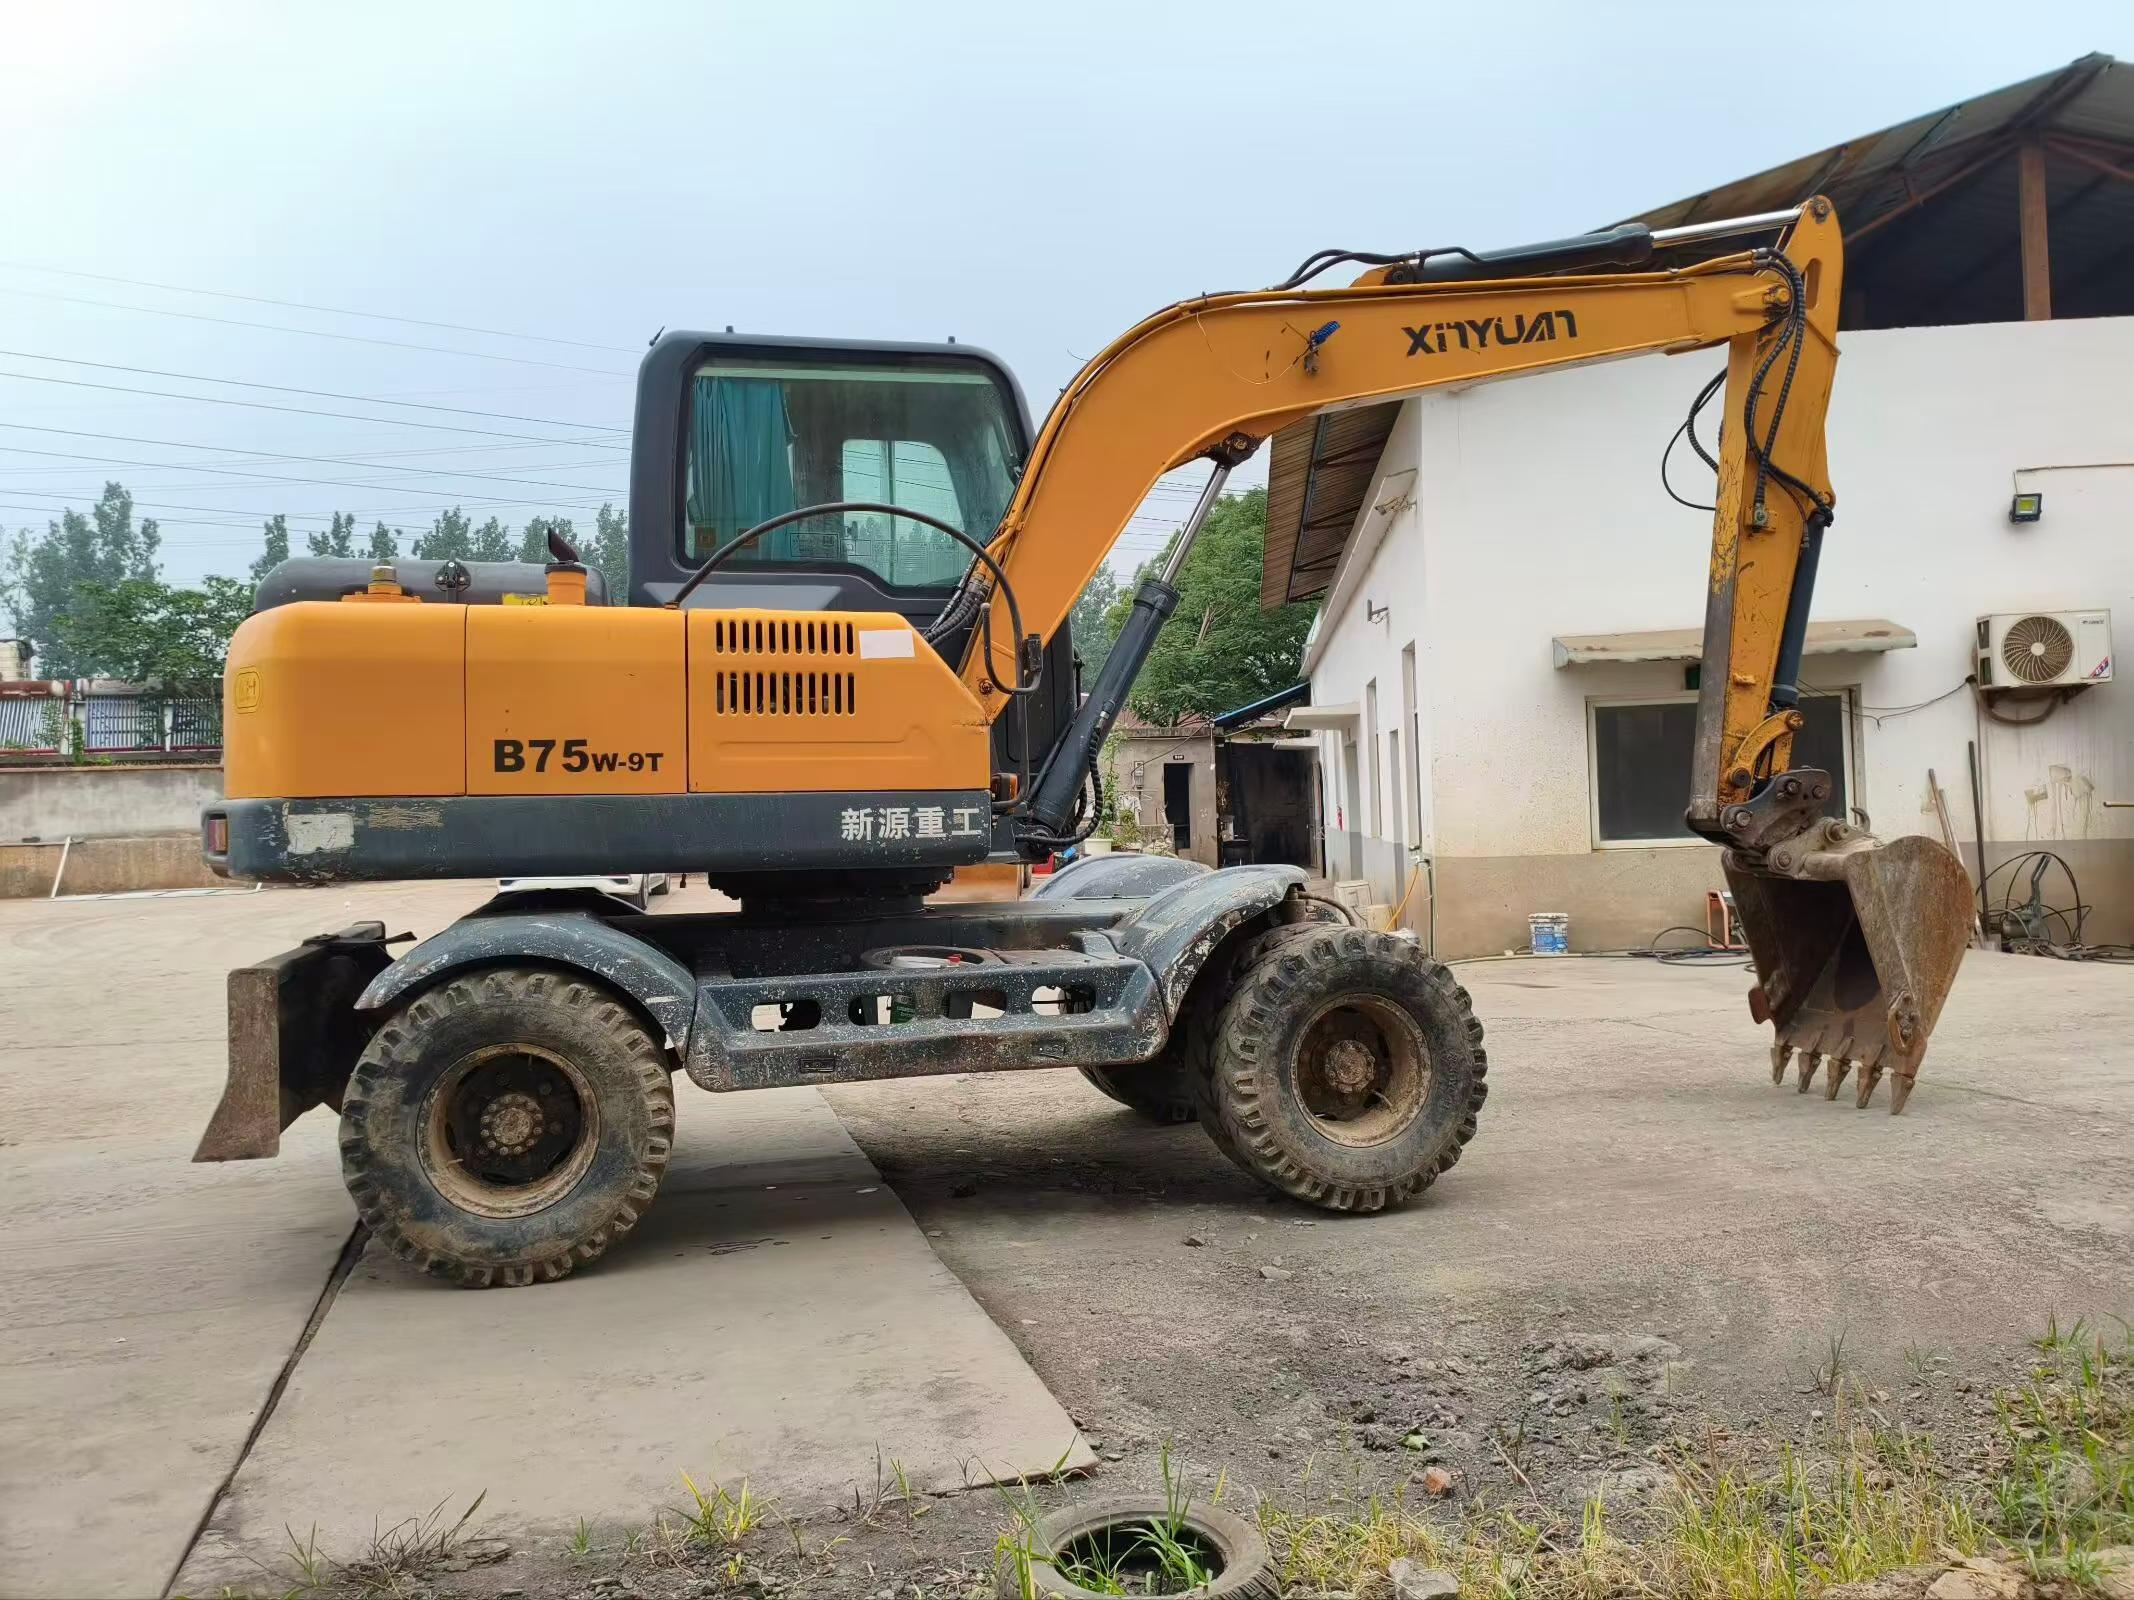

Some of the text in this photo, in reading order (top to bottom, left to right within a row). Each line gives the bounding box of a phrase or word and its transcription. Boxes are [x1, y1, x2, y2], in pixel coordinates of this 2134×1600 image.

[494, 739, 664, 773] B75W-9T
[841, 806, 982, 841] 新源重工
